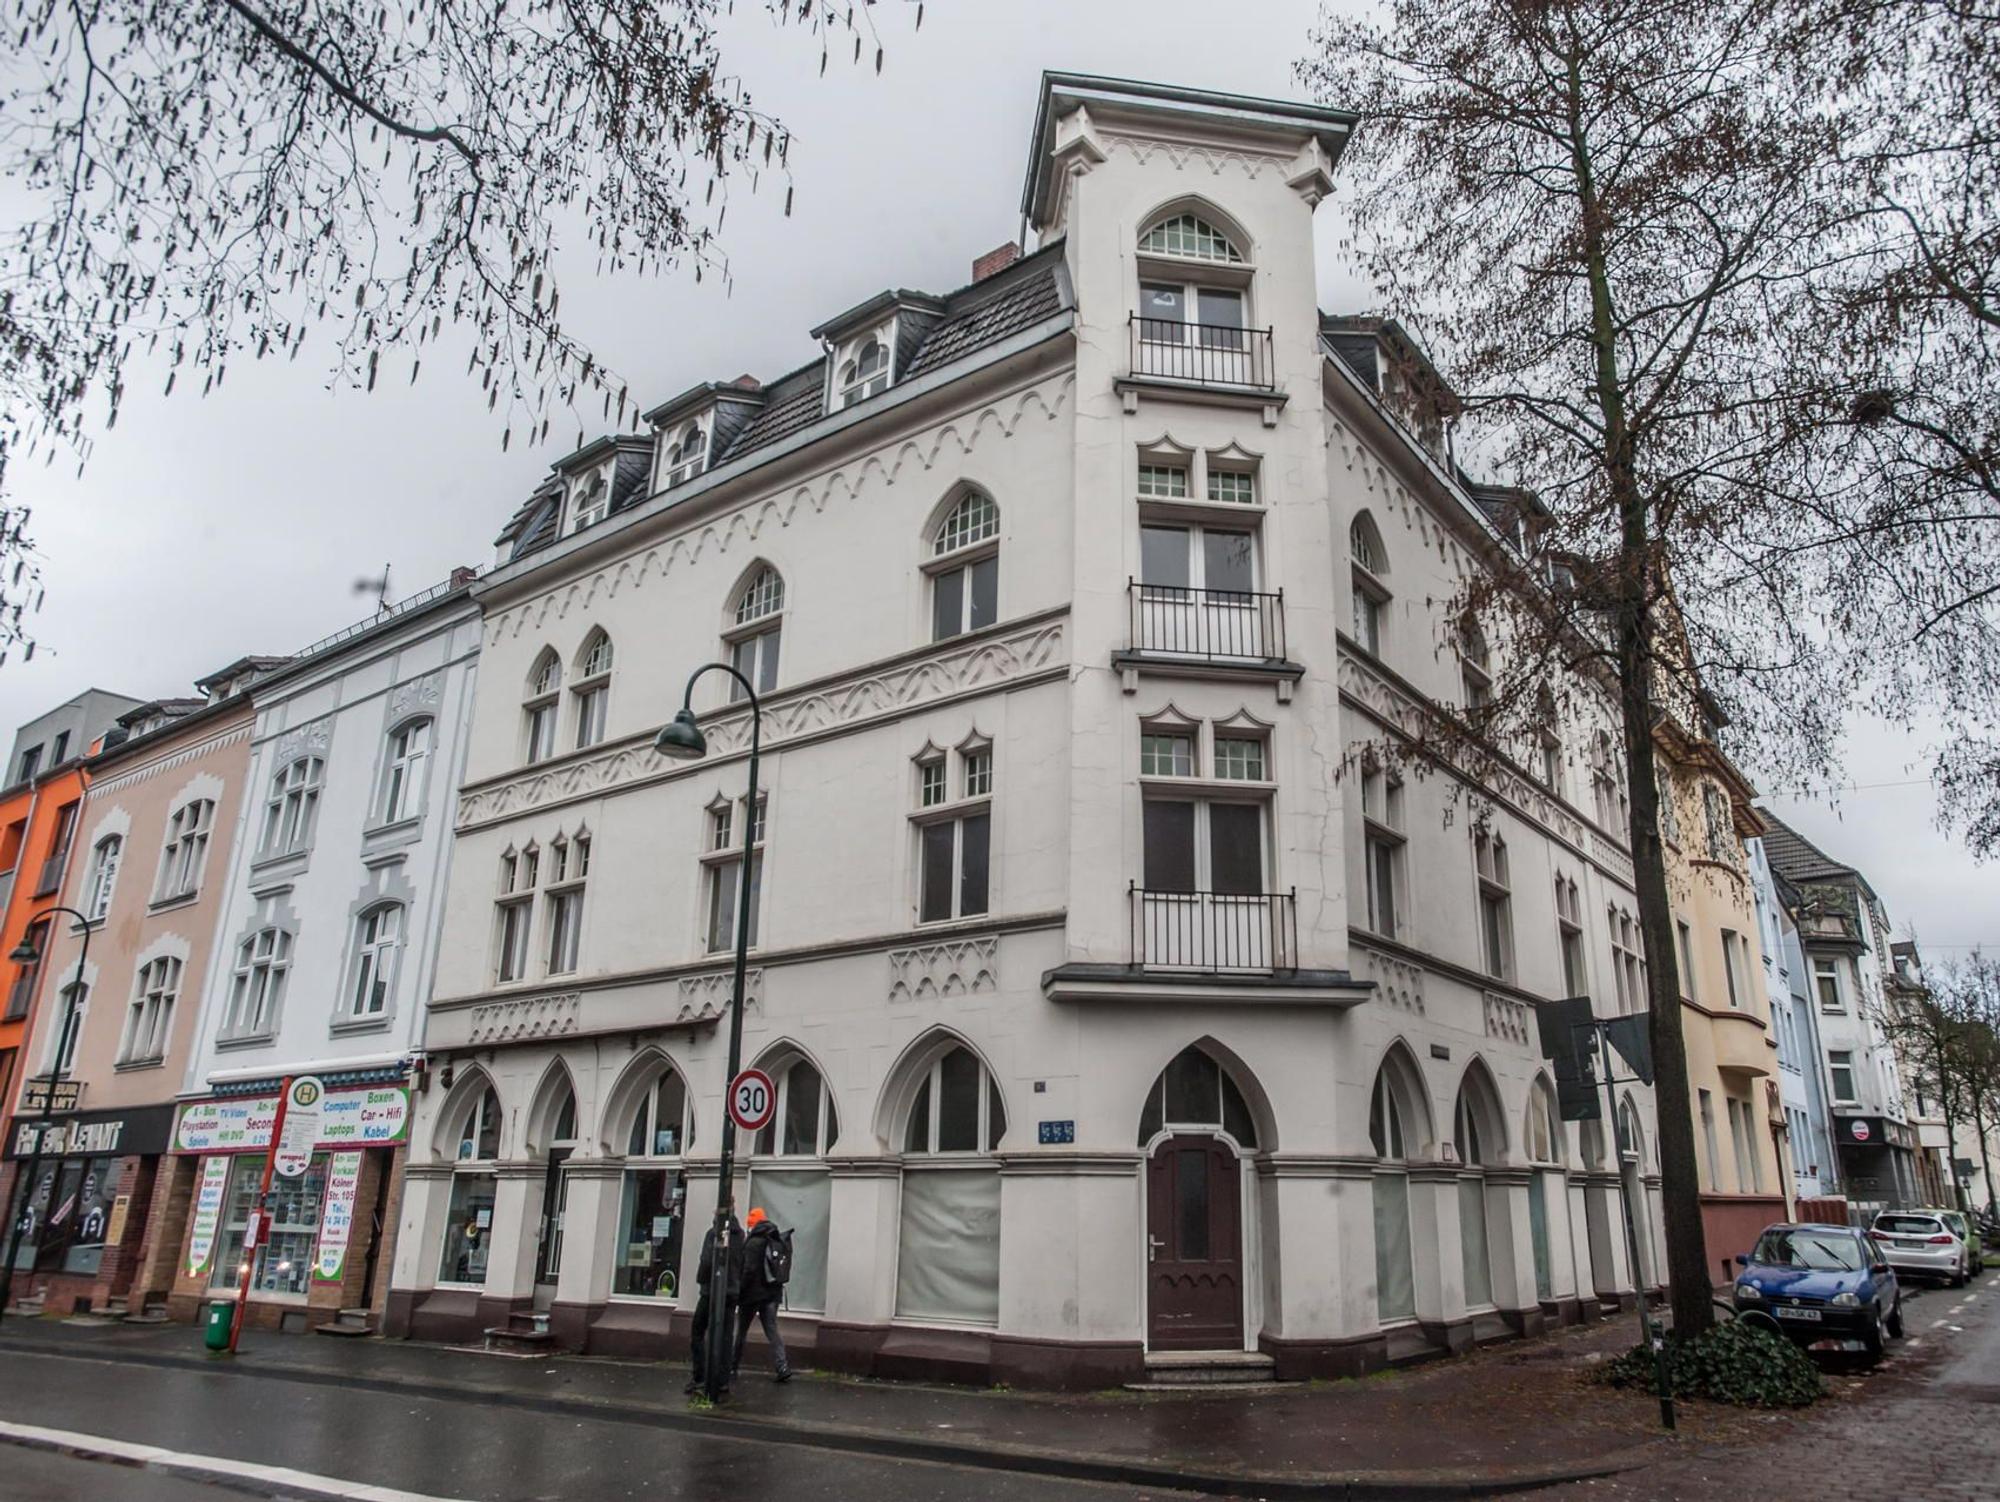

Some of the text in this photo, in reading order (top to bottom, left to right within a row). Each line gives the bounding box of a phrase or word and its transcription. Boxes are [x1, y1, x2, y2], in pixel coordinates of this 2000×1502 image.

[300, 1086, 313, 1101] H
[367, 1092, 395, 1103] Boxen
[739, 1086, 765, 1114] 30
[323, 1101, 361, 1113] Computer
[361, 1109, 376, 1121] Car
[386, 1107, 402, 1120] Hifi
[182, 1120, 219, 1133] Playstation
[246, 1117, 276, 1130] Secon
[323, 1124, 355, 1137] Laptops
[363, 1125, 390, 1138] Kabel
[332, 1177, 353, 1188] Kölner
[342, 1190, 355, 1200] 105
